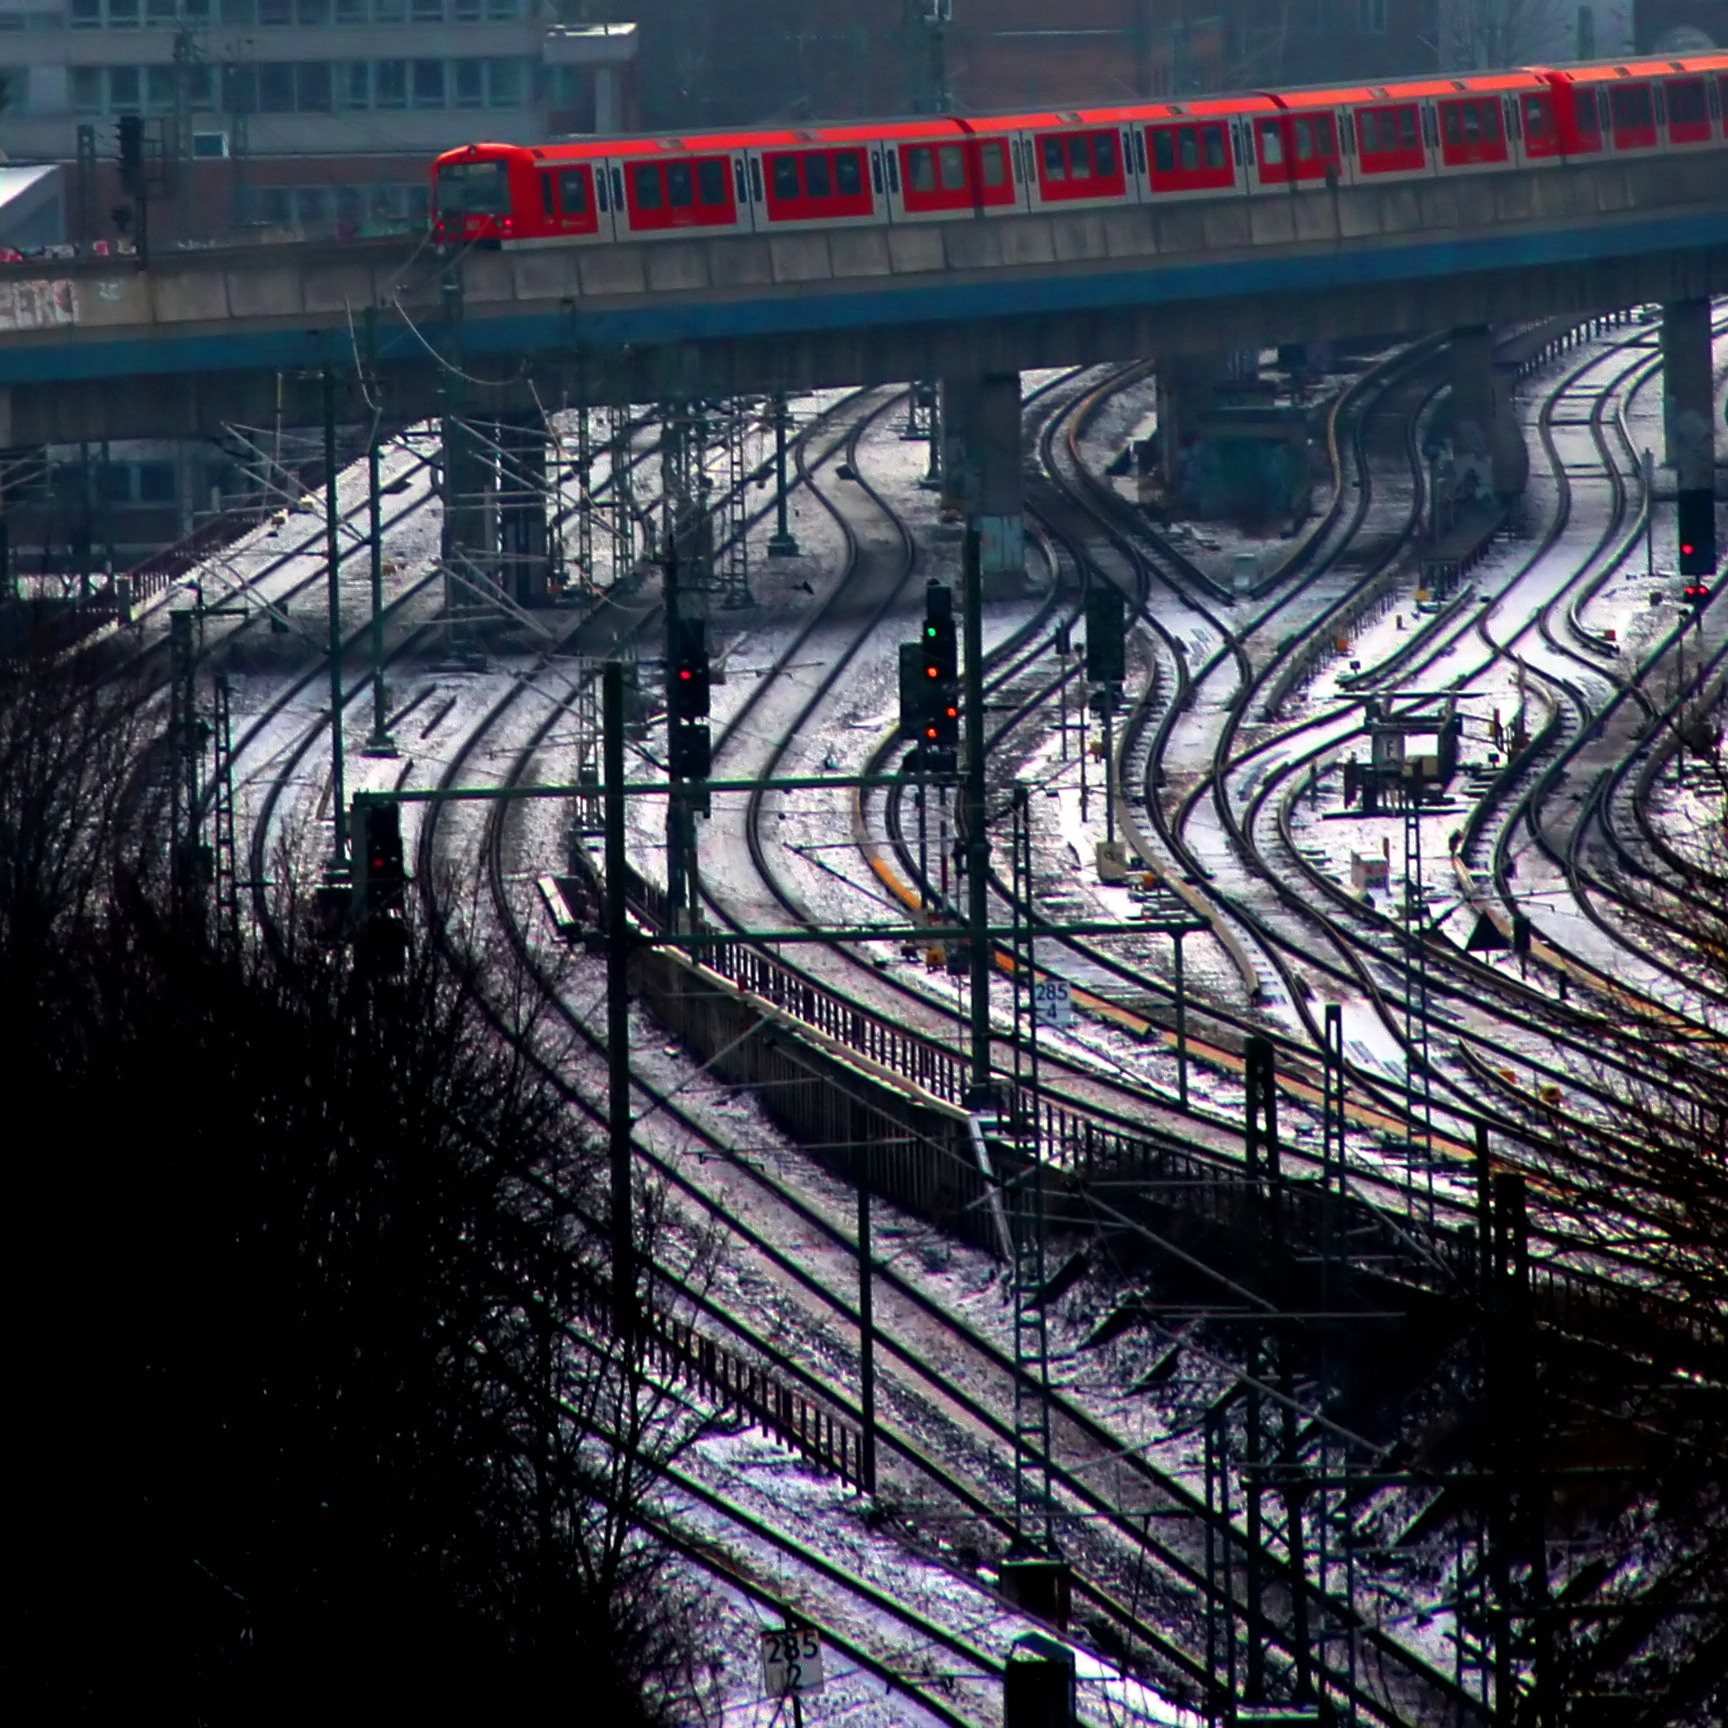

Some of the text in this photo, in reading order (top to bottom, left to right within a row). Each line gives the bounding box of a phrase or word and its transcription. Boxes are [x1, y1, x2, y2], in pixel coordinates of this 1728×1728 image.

[1035, 982, 1068, 1001] 285
[1047, 1002, 1057, 1020] 4
[765, 1632, 818, 1663] 285
[787, 1663, 803, 1690] 2
